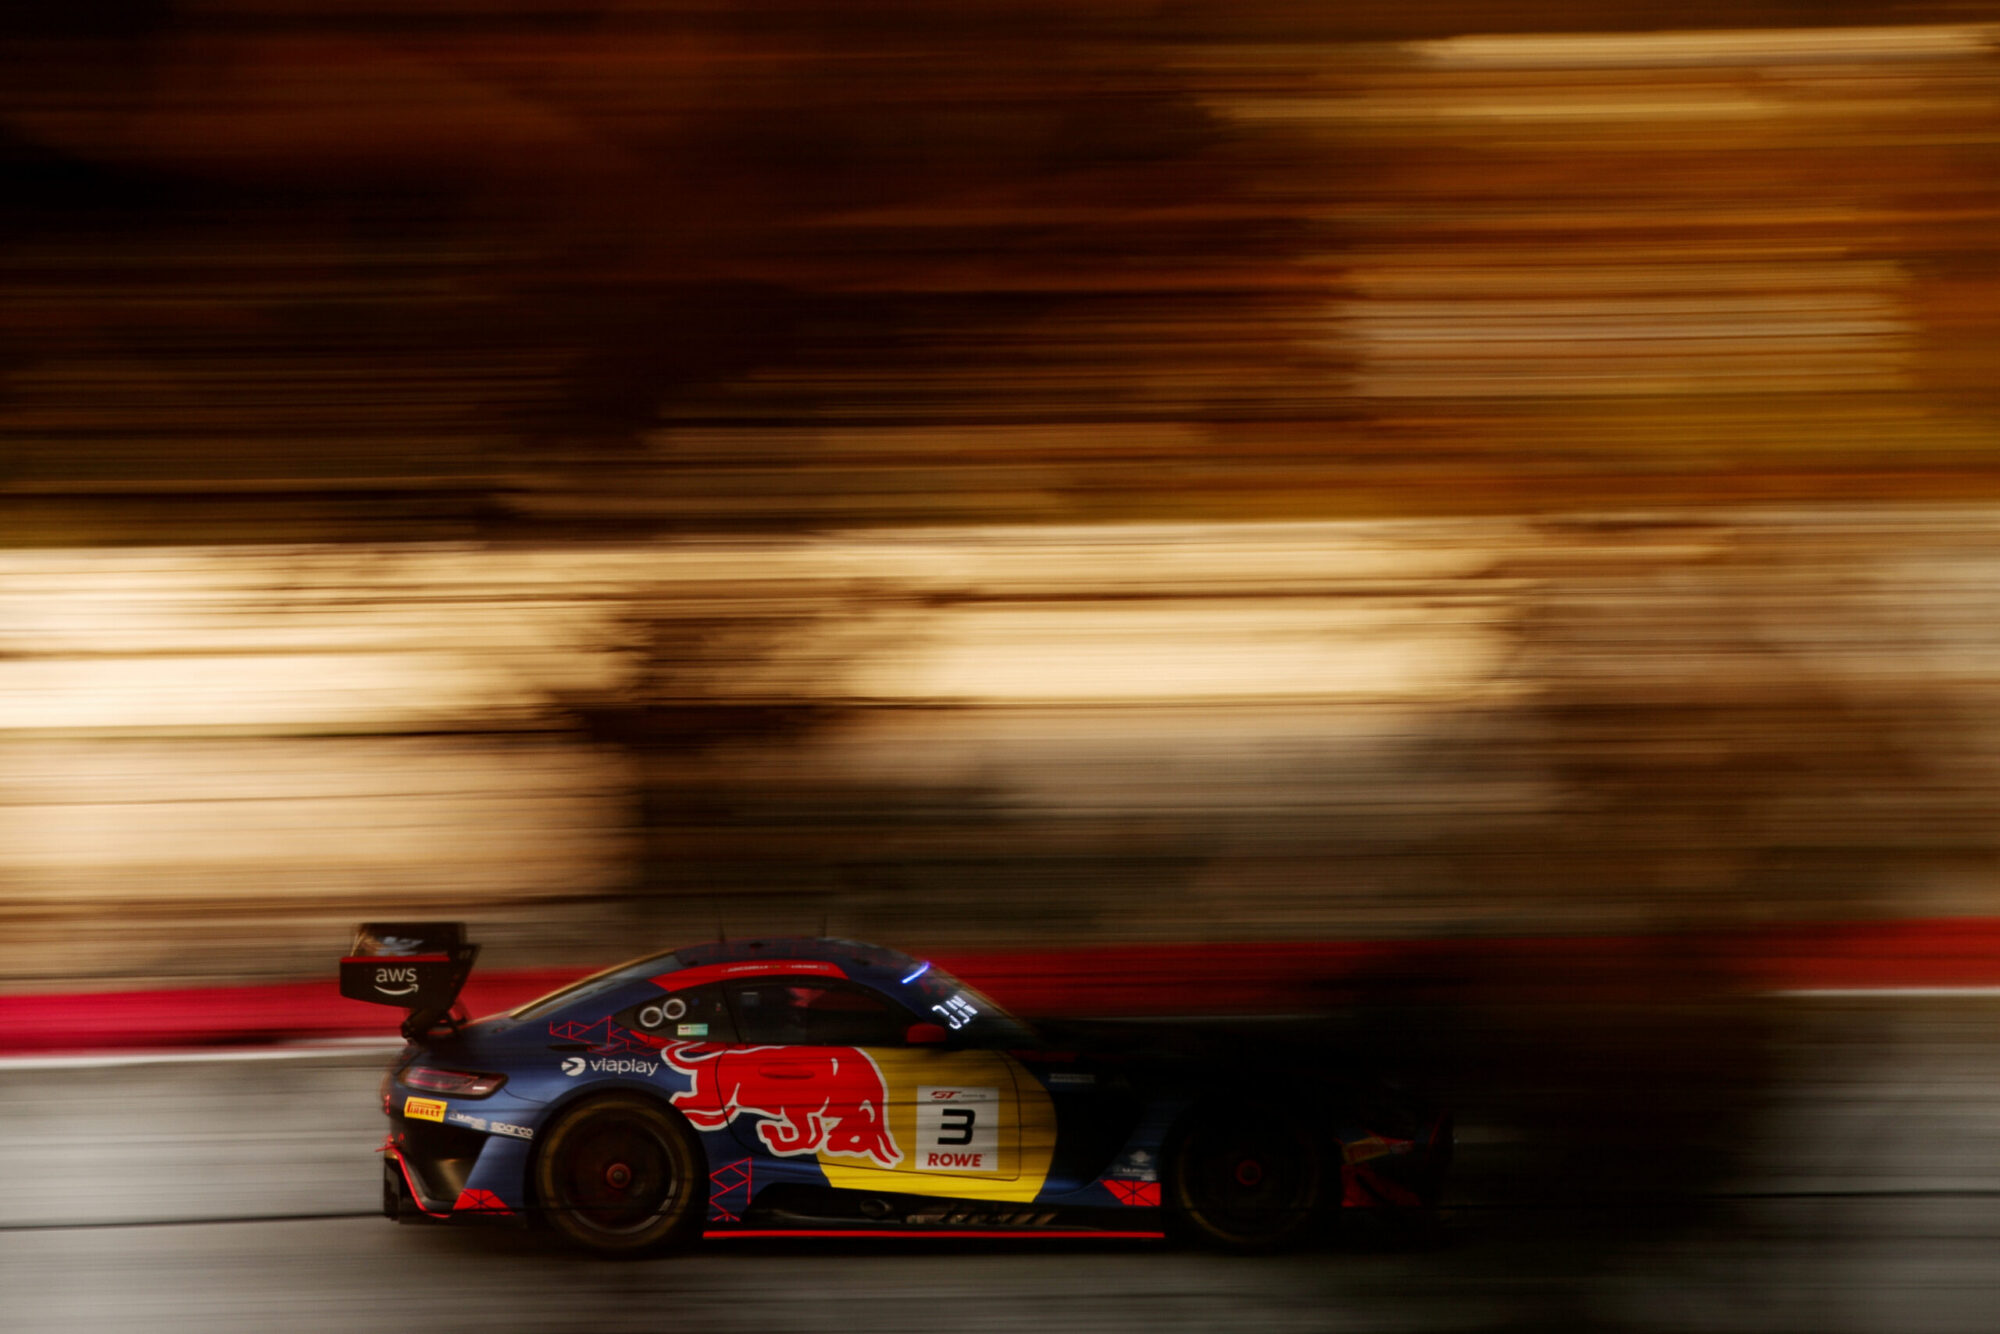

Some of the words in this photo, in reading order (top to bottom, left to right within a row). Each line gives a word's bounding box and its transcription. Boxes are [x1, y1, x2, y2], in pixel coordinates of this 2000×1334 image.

[375, 967, 418, 983] aws
[589, 1057, 659, 1077] viaplay
[937, 1108, 976, 1145] 3
[927, 1152, 985, 1167] ROWE
